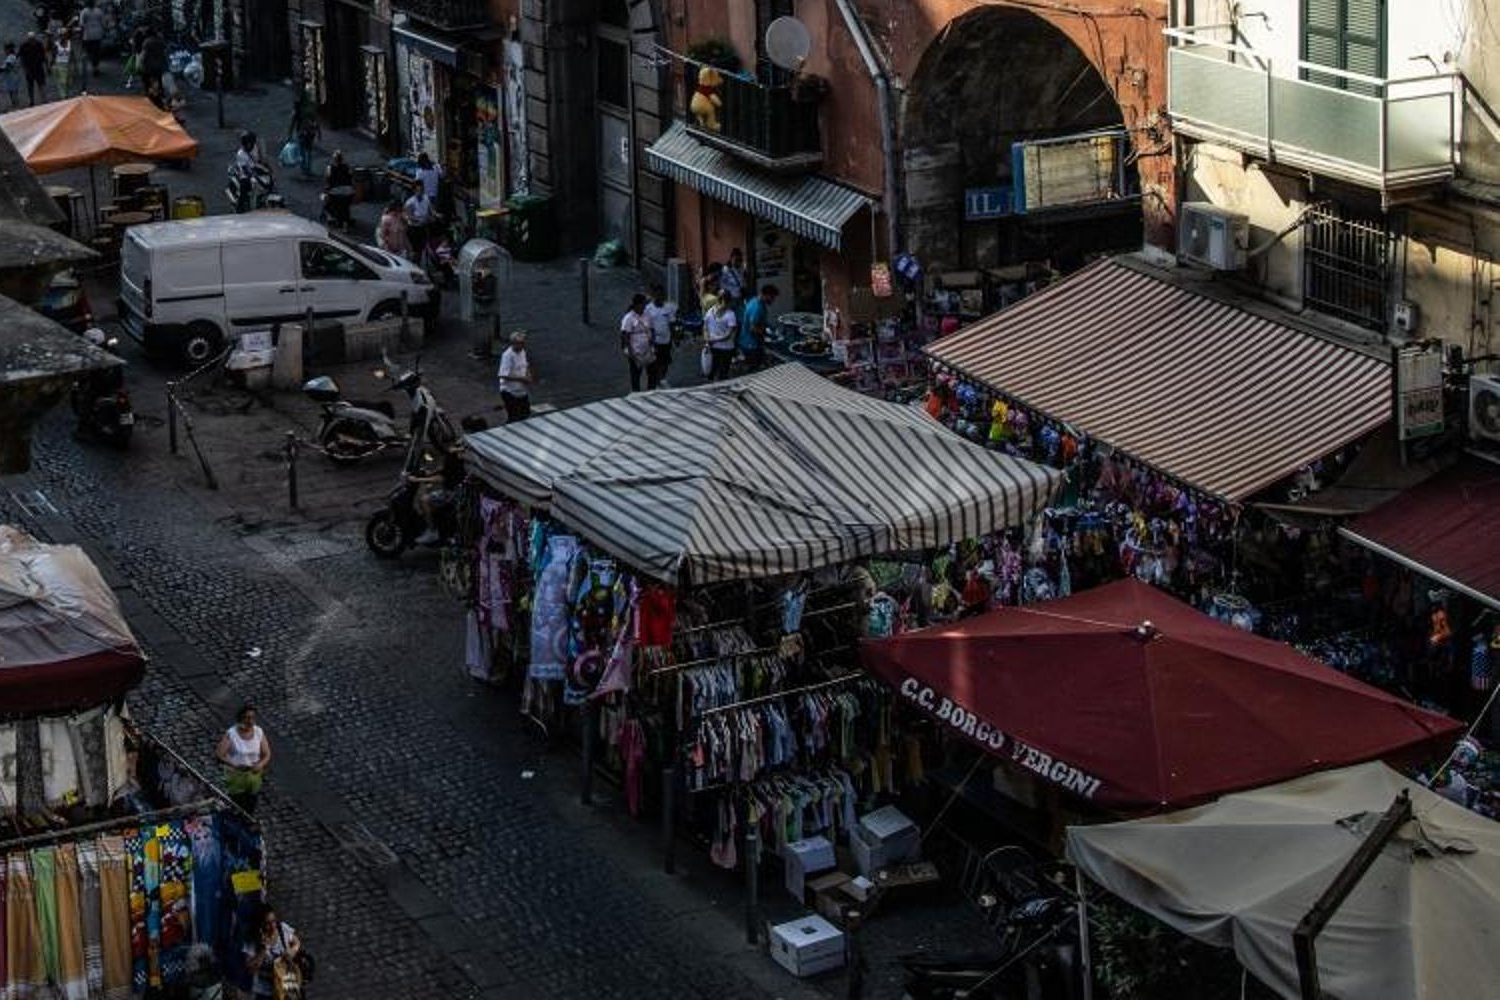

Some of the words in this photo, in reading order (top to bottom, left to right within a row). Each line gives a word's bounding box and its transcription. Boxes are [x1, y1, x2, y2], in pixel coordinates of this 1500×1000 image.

[900, 676, 935, 710] C.C.
[935, 696, 1005, 750] BORGO
[1011, 740, 1103, 799] VERGINI
